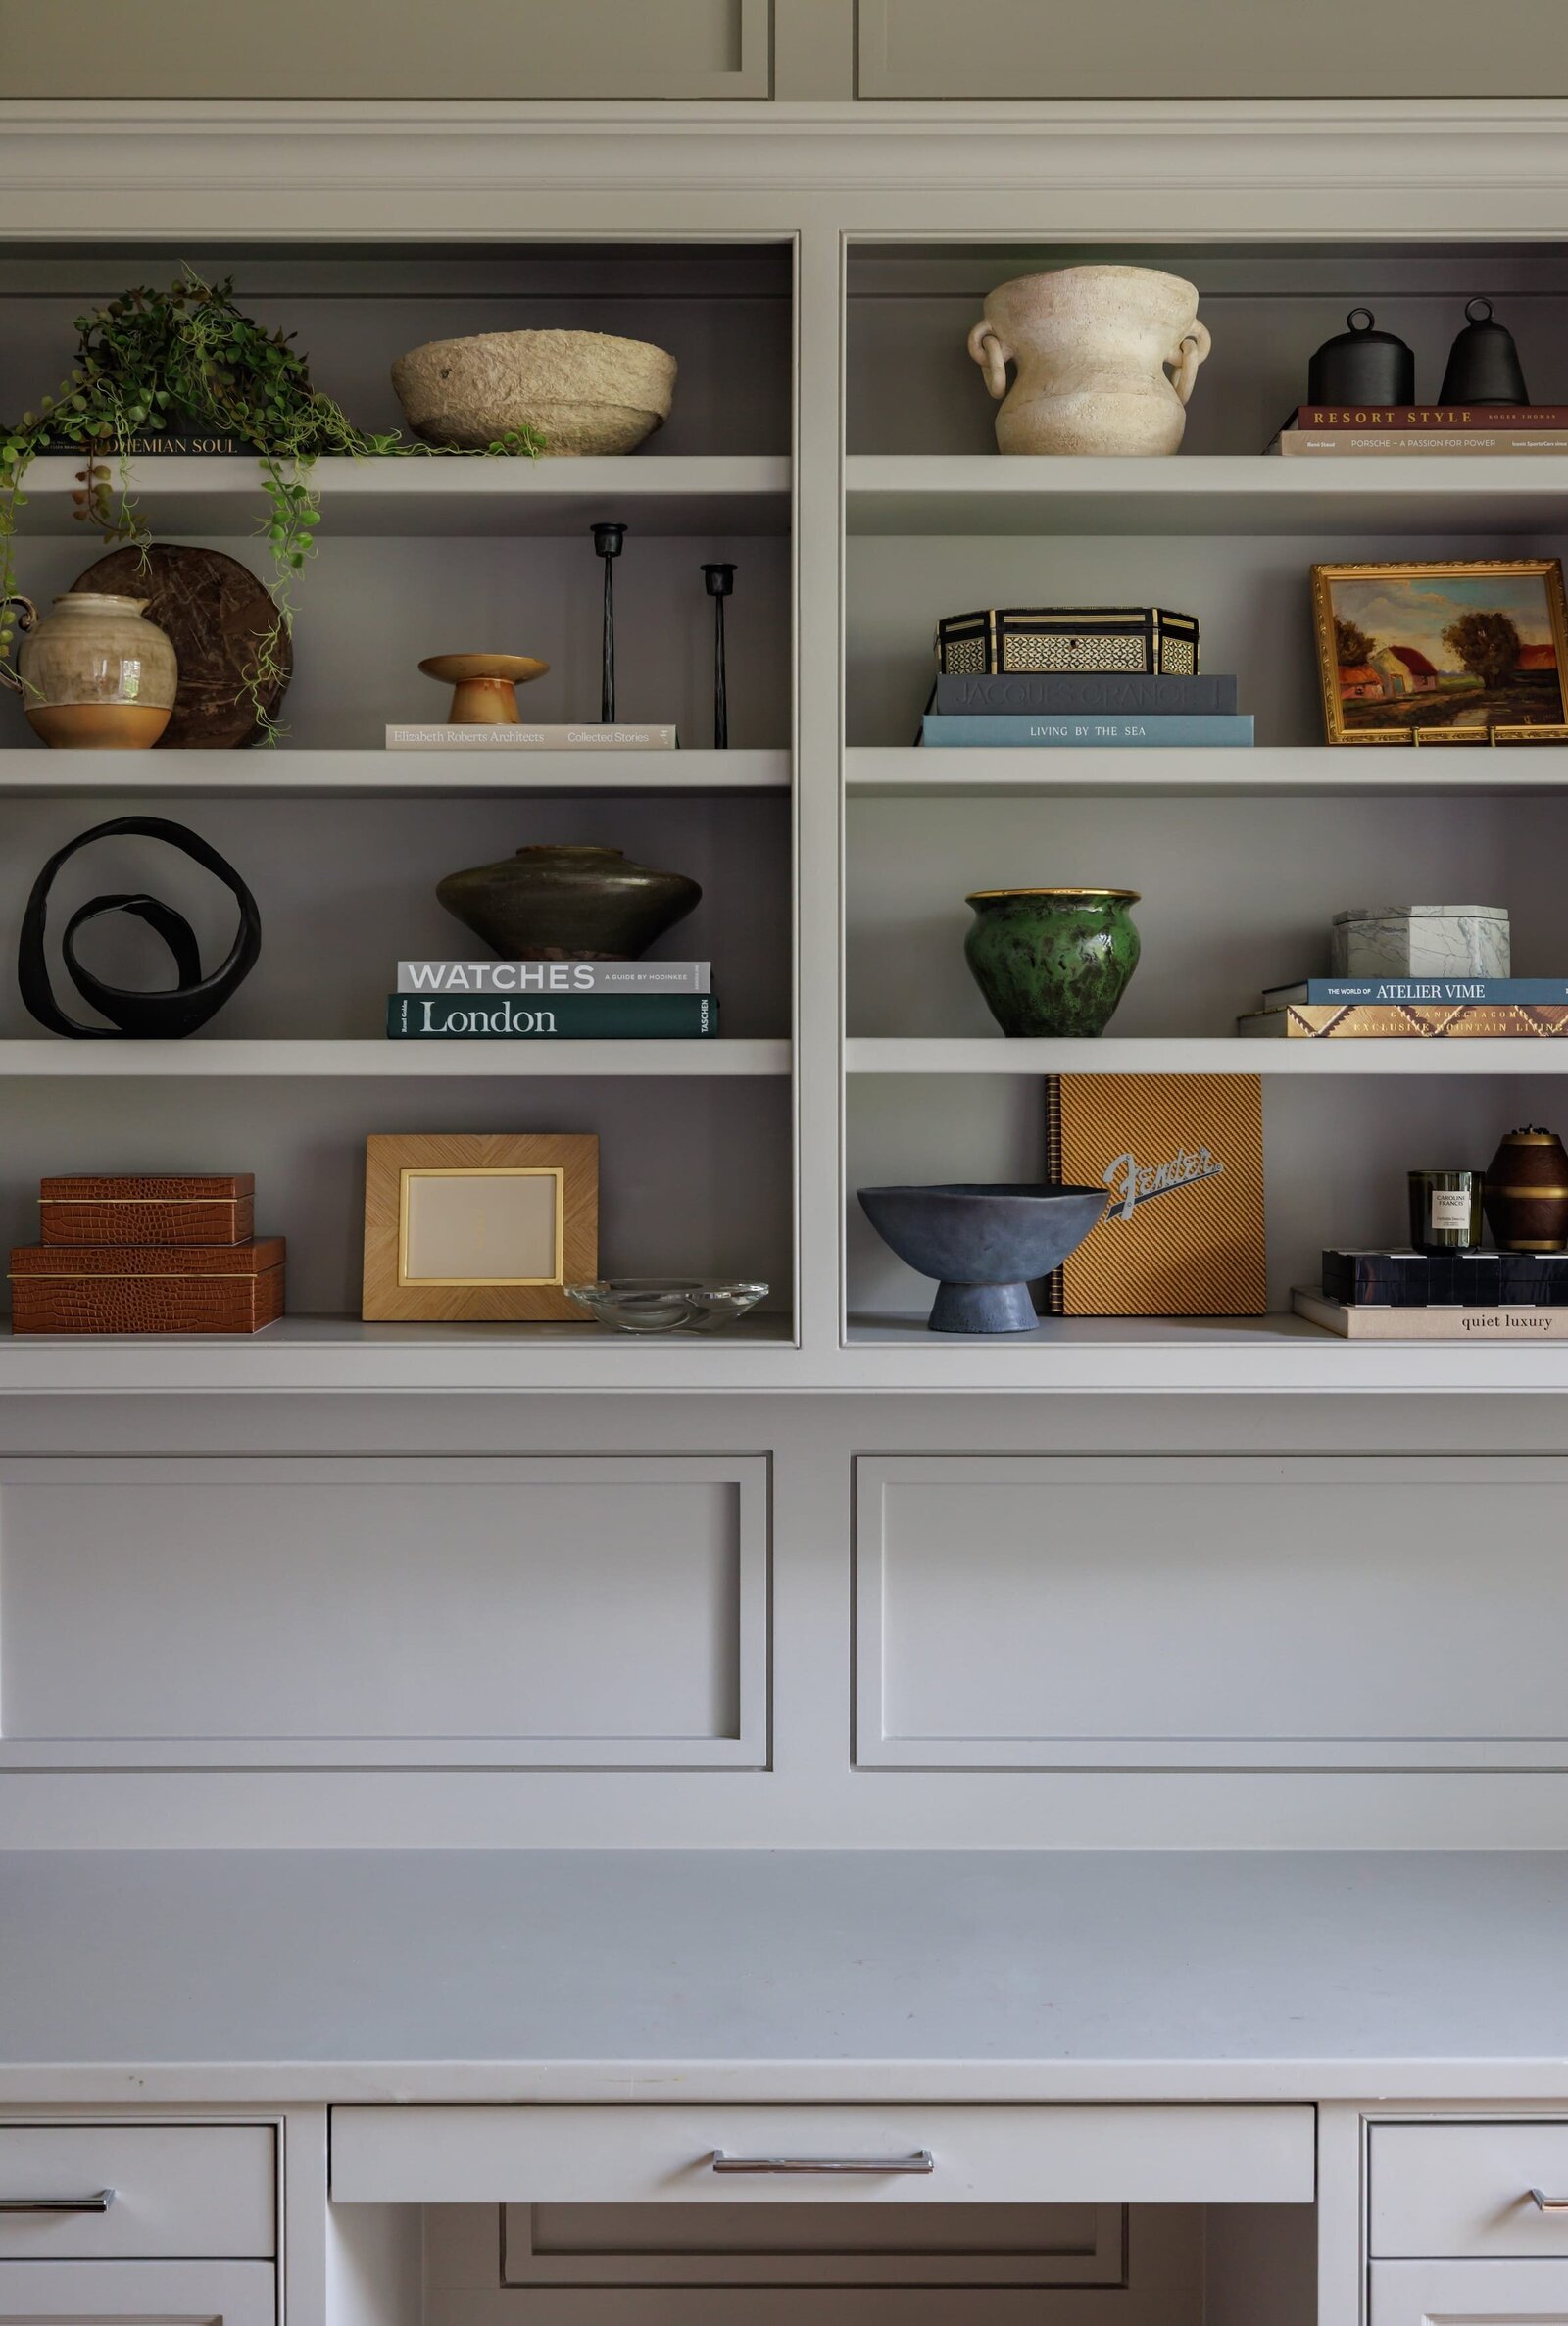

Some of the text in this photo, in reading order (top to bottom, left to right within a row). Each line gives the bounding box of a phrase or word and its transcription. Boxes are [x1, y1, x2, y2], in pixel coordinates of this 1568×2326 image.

[1313, 412, 1472, 423] RESORT STYLE
[192, 438, 237, 453] SOUL
[956, 679, 1196, 708] JACQUES GRANGE
[394, 730, 544, 742] Elizabeth Roberts Architects
[567, 731, 649, 742] Collected Stories
[1030, 726, 1146, 736] LIVING BY THE SEA
[408, 965, 595, 989] WATCHES
[1376, 985, 1486, 999] ATELIER VIME
[419, 1000, 557, 1032] London
[1354, 1023, 1563, 1032] EXCLUSIVE MOUNTAIN LIVING
[1102, 1145, 1223, 1220] Fender
[1462, 1314, 1553, 1330] quiet luxury
